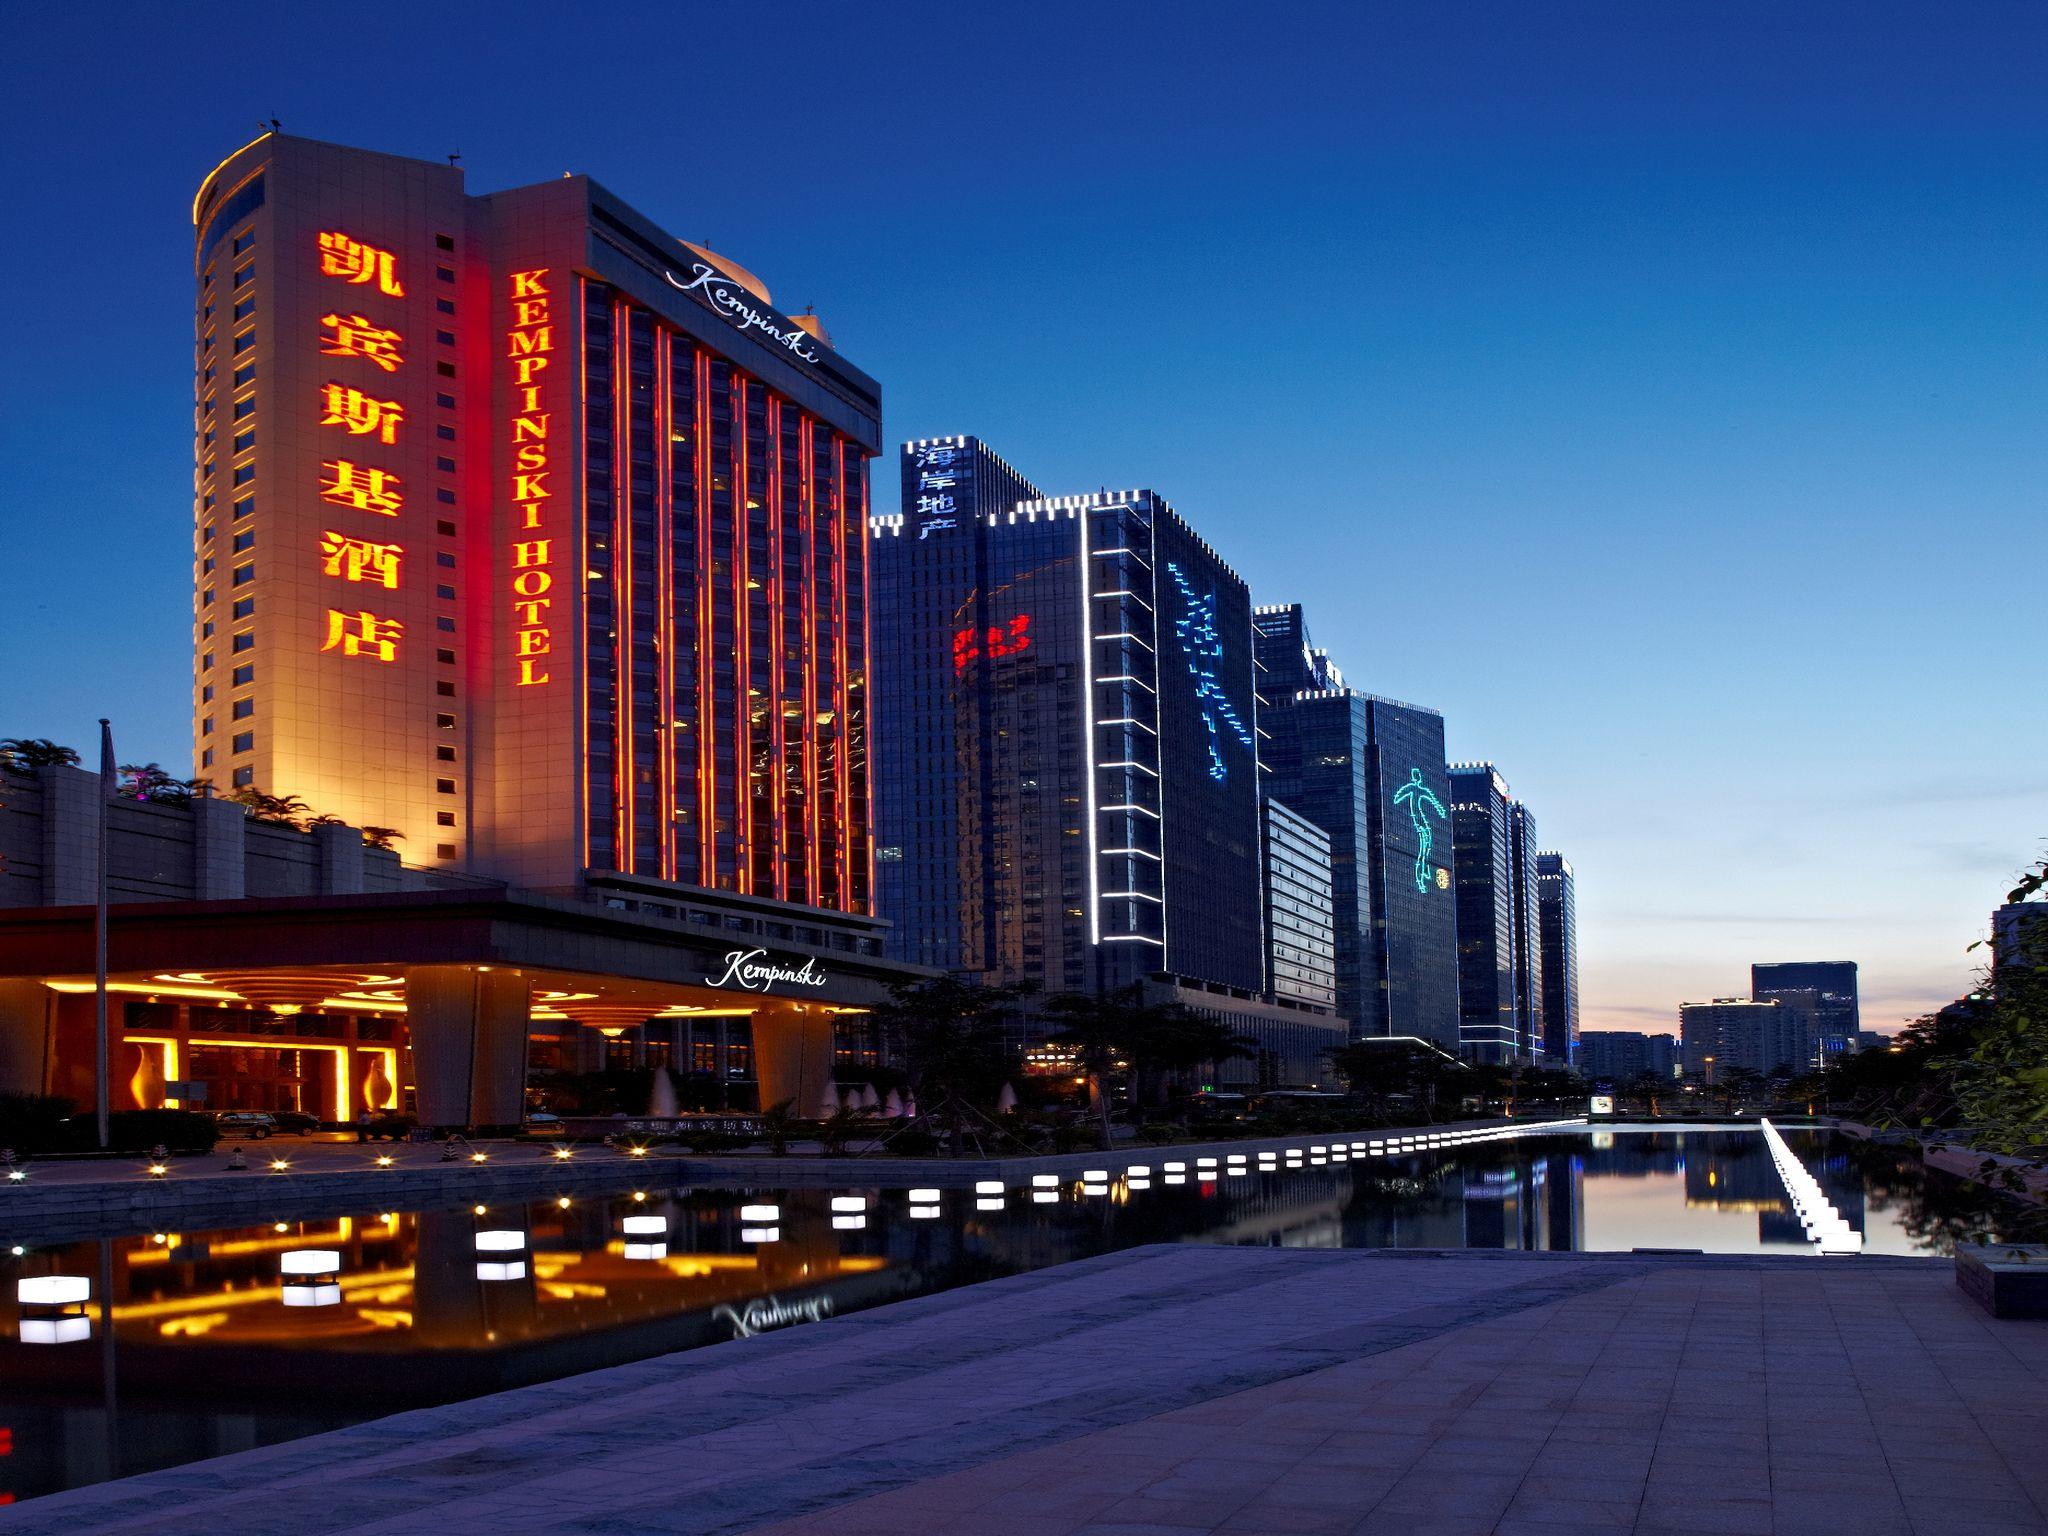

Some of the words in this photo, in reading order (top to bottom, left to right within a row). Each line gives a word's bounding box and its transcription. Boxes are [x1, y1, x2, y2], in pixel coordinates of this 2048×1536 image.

[665, 263, 820, 364] Kempinski
[317, 231, 404, 663] 凯宾斯基酒店
[507, 268, 553, 530] KEMPINSKI
[916, 445, 957, 540] 海岸地产
[512, 539, 553, 687] HOTEL
[705, 948, 827, 993] Kempinski
